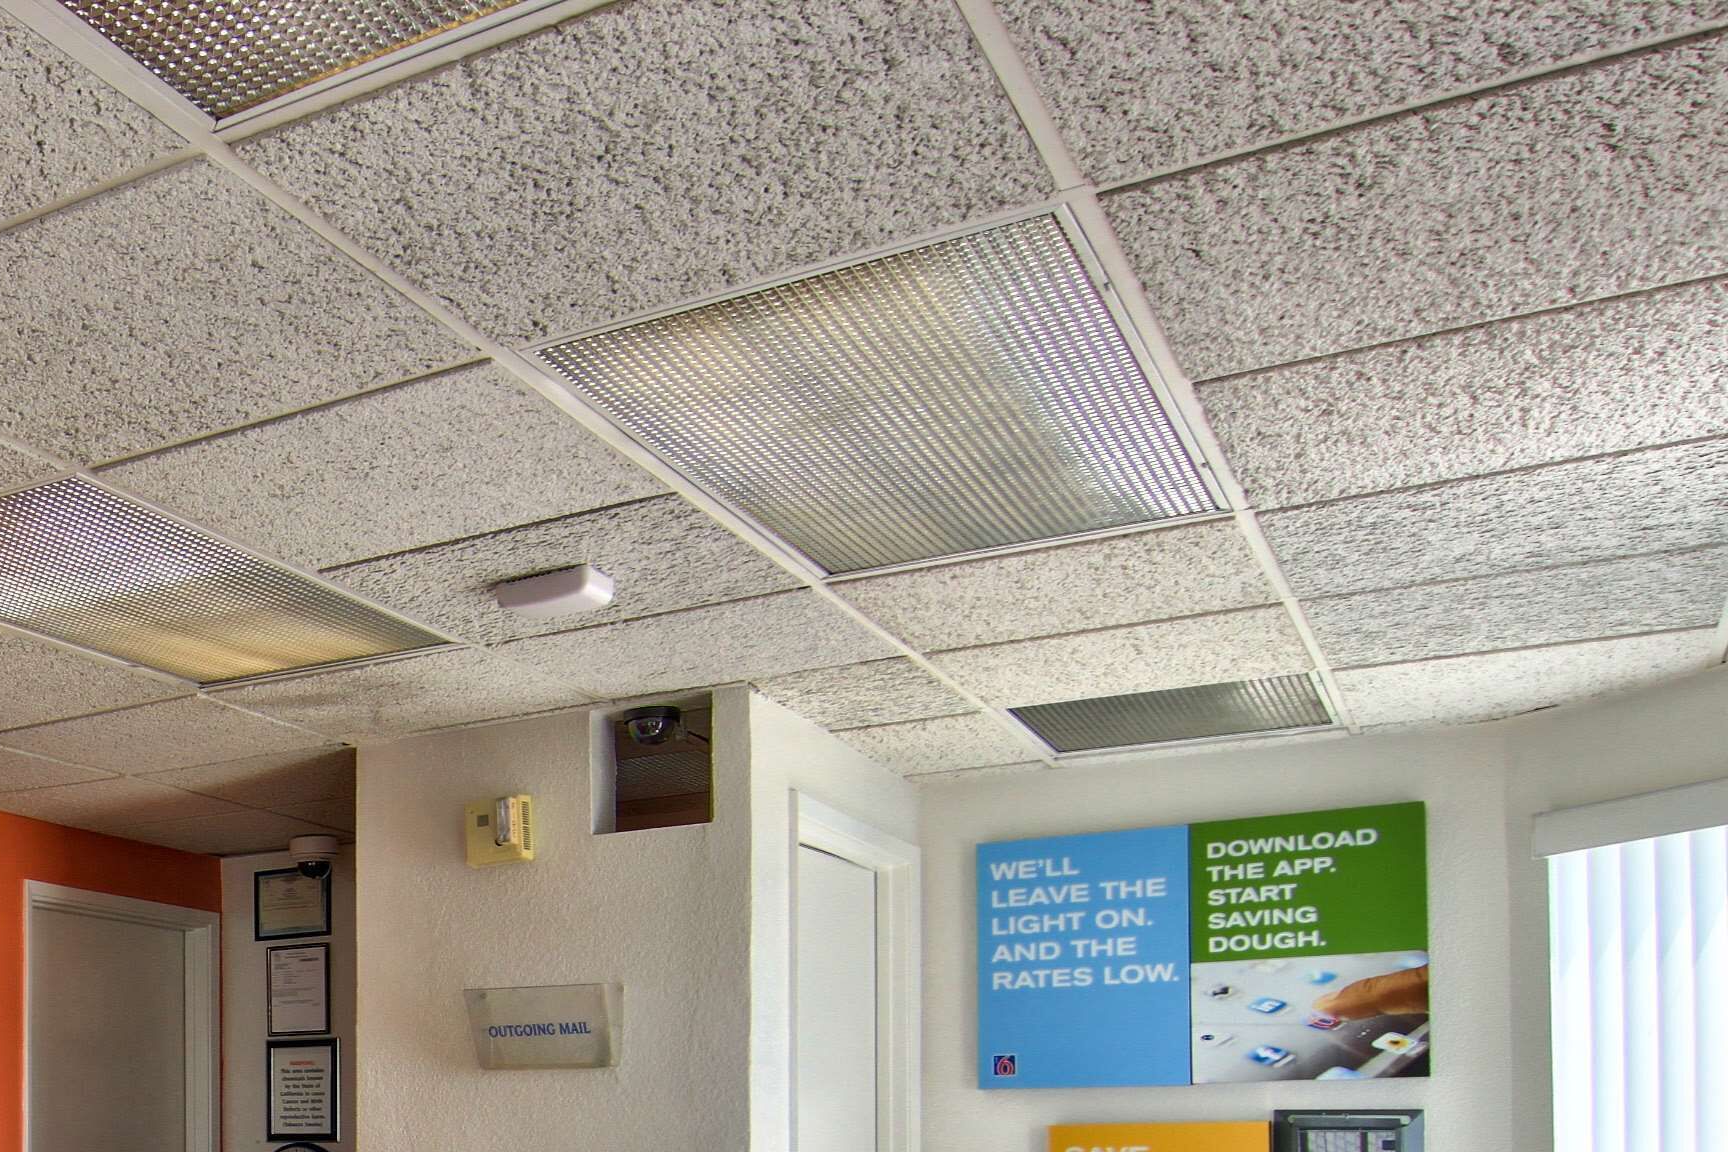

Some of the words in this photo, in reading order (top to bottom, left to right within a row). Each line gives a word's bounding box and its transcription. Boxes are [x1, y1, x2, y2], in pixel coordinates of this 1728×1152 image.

[1206, 828, 1378, 859] DOWNLOAD
[990, 856, 1080, 881] WE'LL
[1207, 862, 1265, 882] THE
[1273, 856, 1337, 878] APP.
[991, 884, 1089, 908] LEAVE
[1100, 878, 1167, 899] THE
[1207, 884, 1297, 906] START
[991, 912, 1085, 936] LIGHT
[1095, 908, 1153, 930] ON.
[1207, 906, 1318, 929] SAVING
[991, 940, 1062, 962] AND
[1071, 936, 1137, 957] THE
[1208, 931, 1326, 953] DOUGH.
[991, 966, 1093, 990] RATES
[1103, 962, 1179, 985] LOW.
[489, 1022, 555, 1038] OUTGOING
[559, 1021, 590, 1035] MAIL
